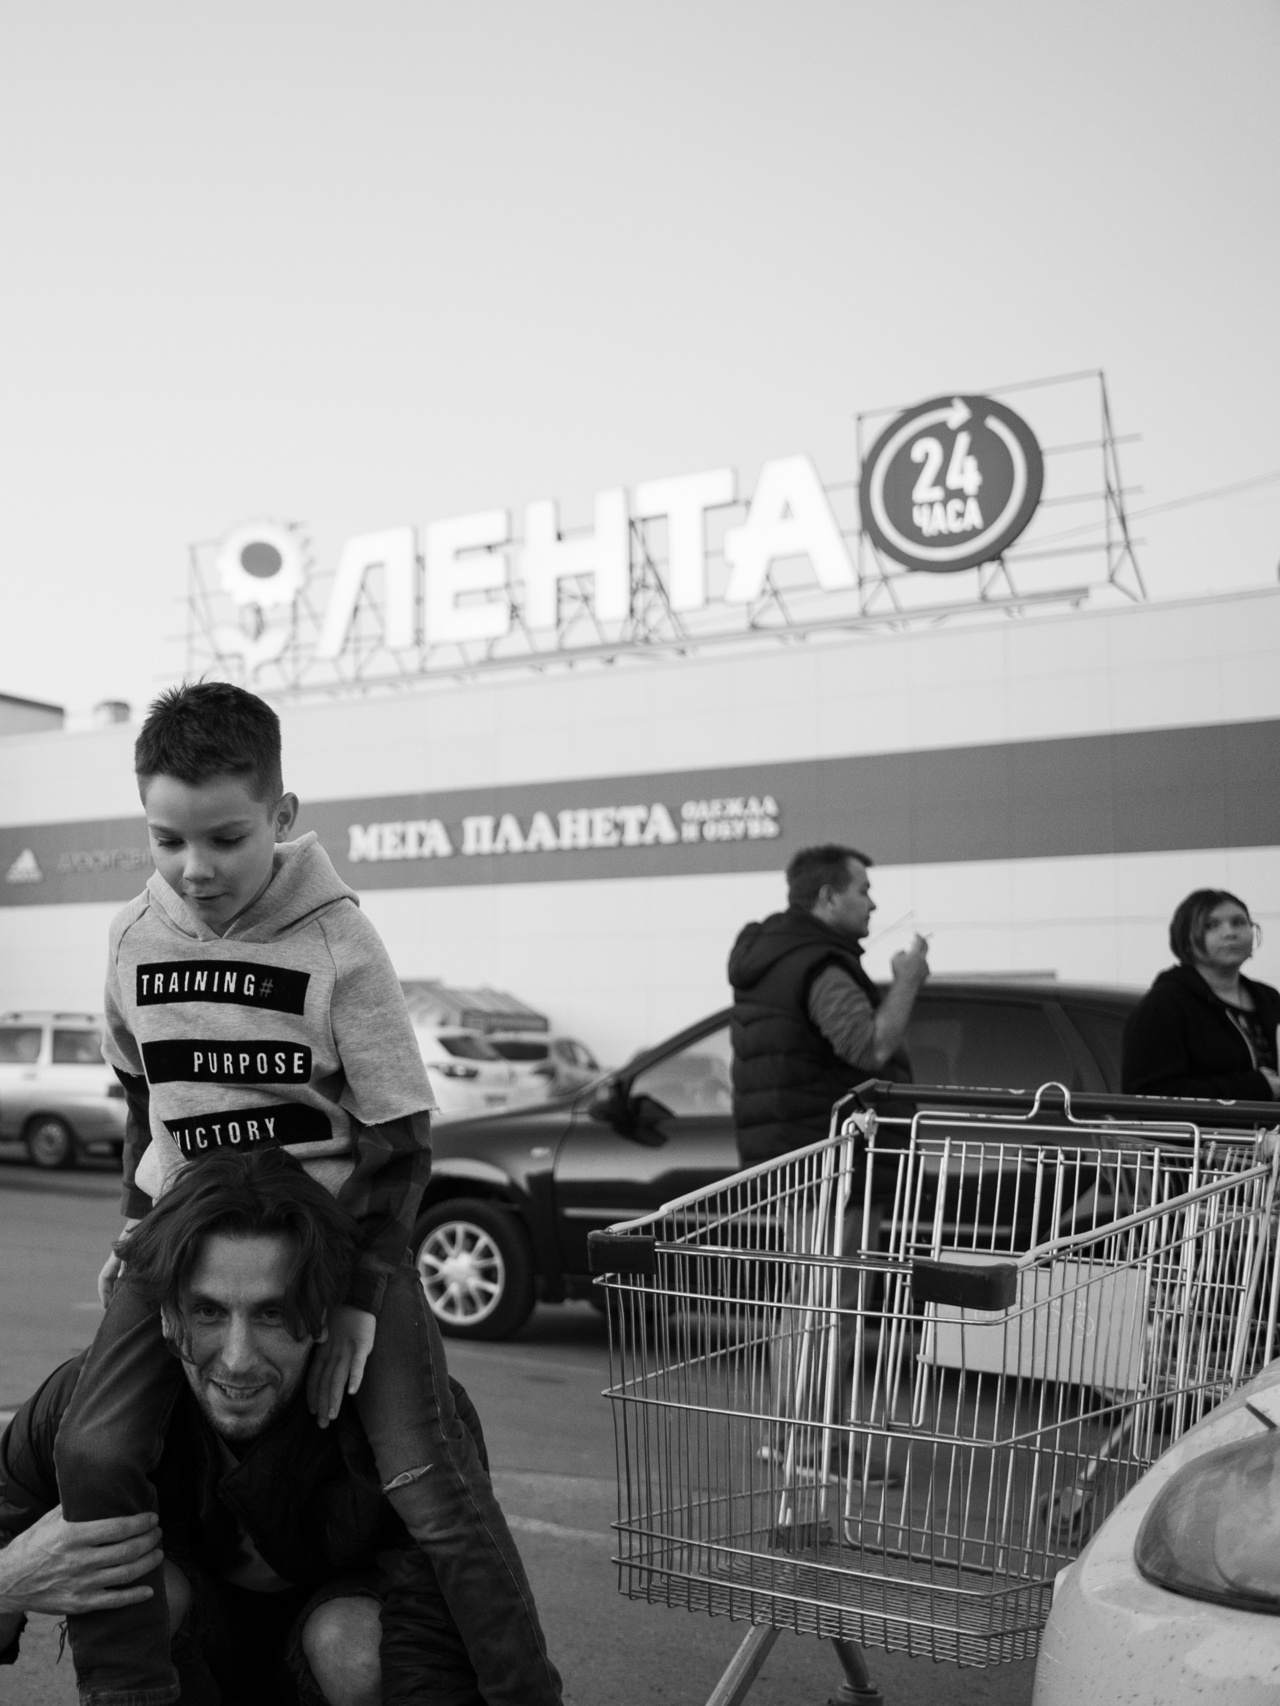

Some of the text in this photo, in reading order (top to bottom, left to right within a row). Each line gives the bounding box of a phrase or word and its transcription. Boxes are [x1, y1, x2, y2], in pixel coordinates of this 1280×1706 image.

[910, 430, 983, 504] 24
[912, 496, 984, 537] ЧАСА
[315, 452, 858, 659] ЛЕНТА
[347, 802, 679, 862] МЕГА ПЛАНЕТА
[193, 1052, 304, 1074] PURPOSE
